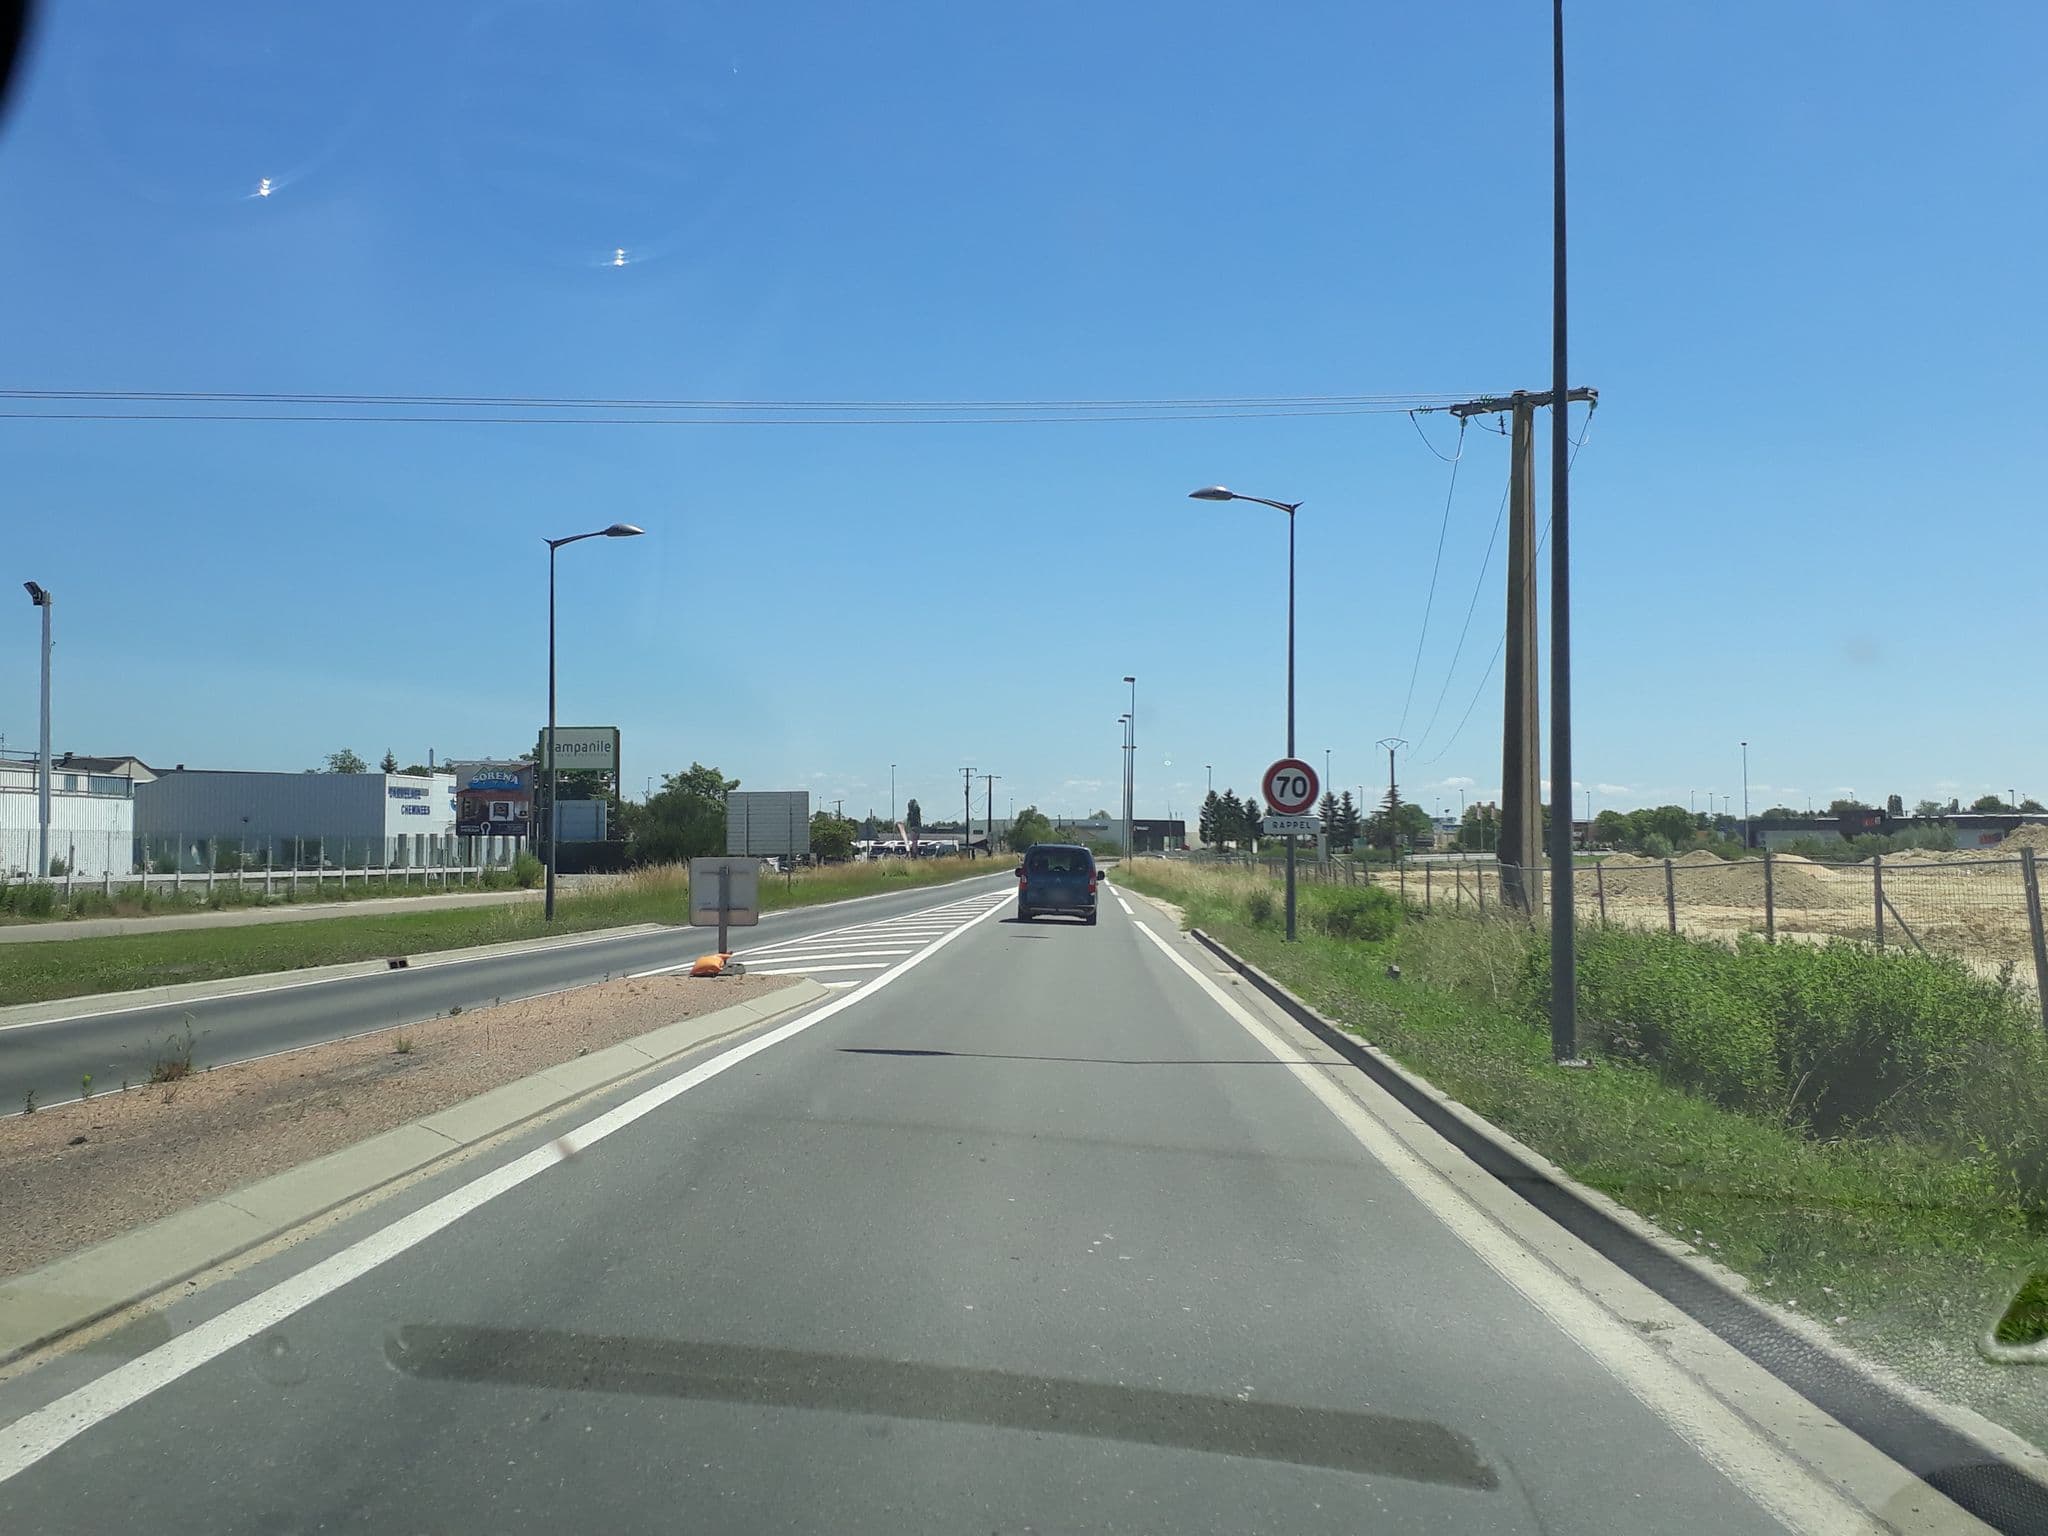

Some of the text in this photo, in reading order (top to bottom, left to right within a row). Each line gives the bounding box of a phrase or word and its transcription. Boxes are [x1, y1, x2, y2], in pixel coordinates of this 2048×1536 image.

[472, 771, 519, 785] SORENA
[1276, 776, 1307, 797] 70
[1272, 821, 1311, 829] RAPPEL
